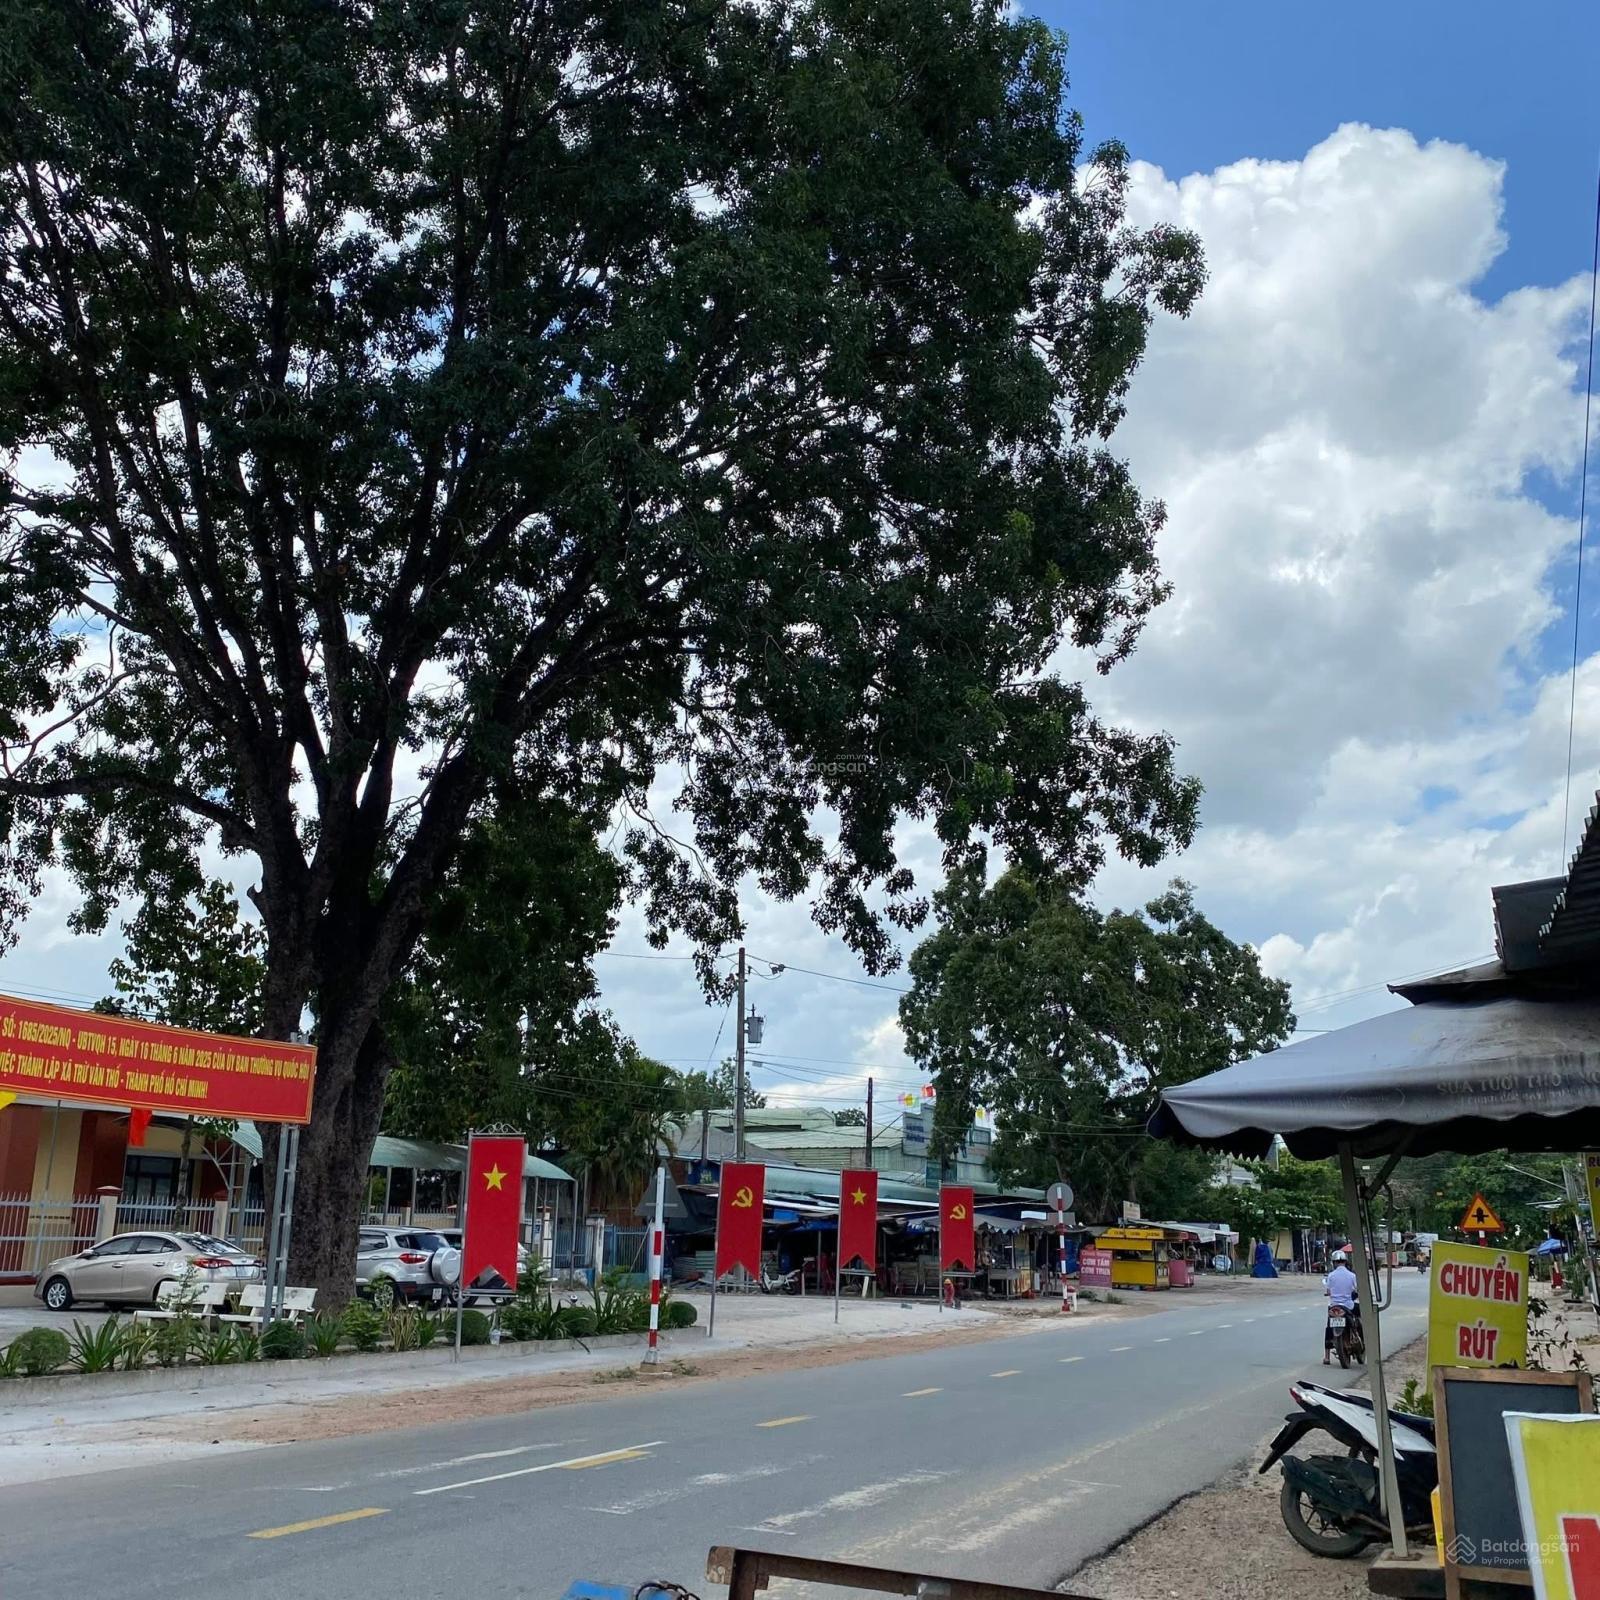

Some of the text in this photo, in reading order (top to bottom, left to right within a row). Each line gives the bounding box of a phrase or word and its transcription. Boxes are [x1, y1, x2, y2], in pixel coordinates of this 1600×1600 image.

[17, 1052, 44, 1078] THÀNH
[44, 1056, 60, 1084] LẬP
[60, 1058, 72, 1082] XÃ
[125, 1068, 150, 1092] THÀNH
[149, 1070, 165, 1094] PHỐ
[175, 1075, 188, 1096] CHÍ
[119, 1035, 140, 1058] NGÀY
[140, 1041, 150, 1060] 16
[150, 1040, 173, 1063] THÁNG
[173, 1046, 178, 1064] 6
[178, 1044, 195, 1067] NĂM
[195, 1049, 212, 1069] 2025
[212, 1047, 225, 1071] CỦA
[235, 1055, 250, 1073] BAN
[1440, 1256, 1519, 1302] CHUYỂN
[1459, 1321, 1497, 1360] RÚT
